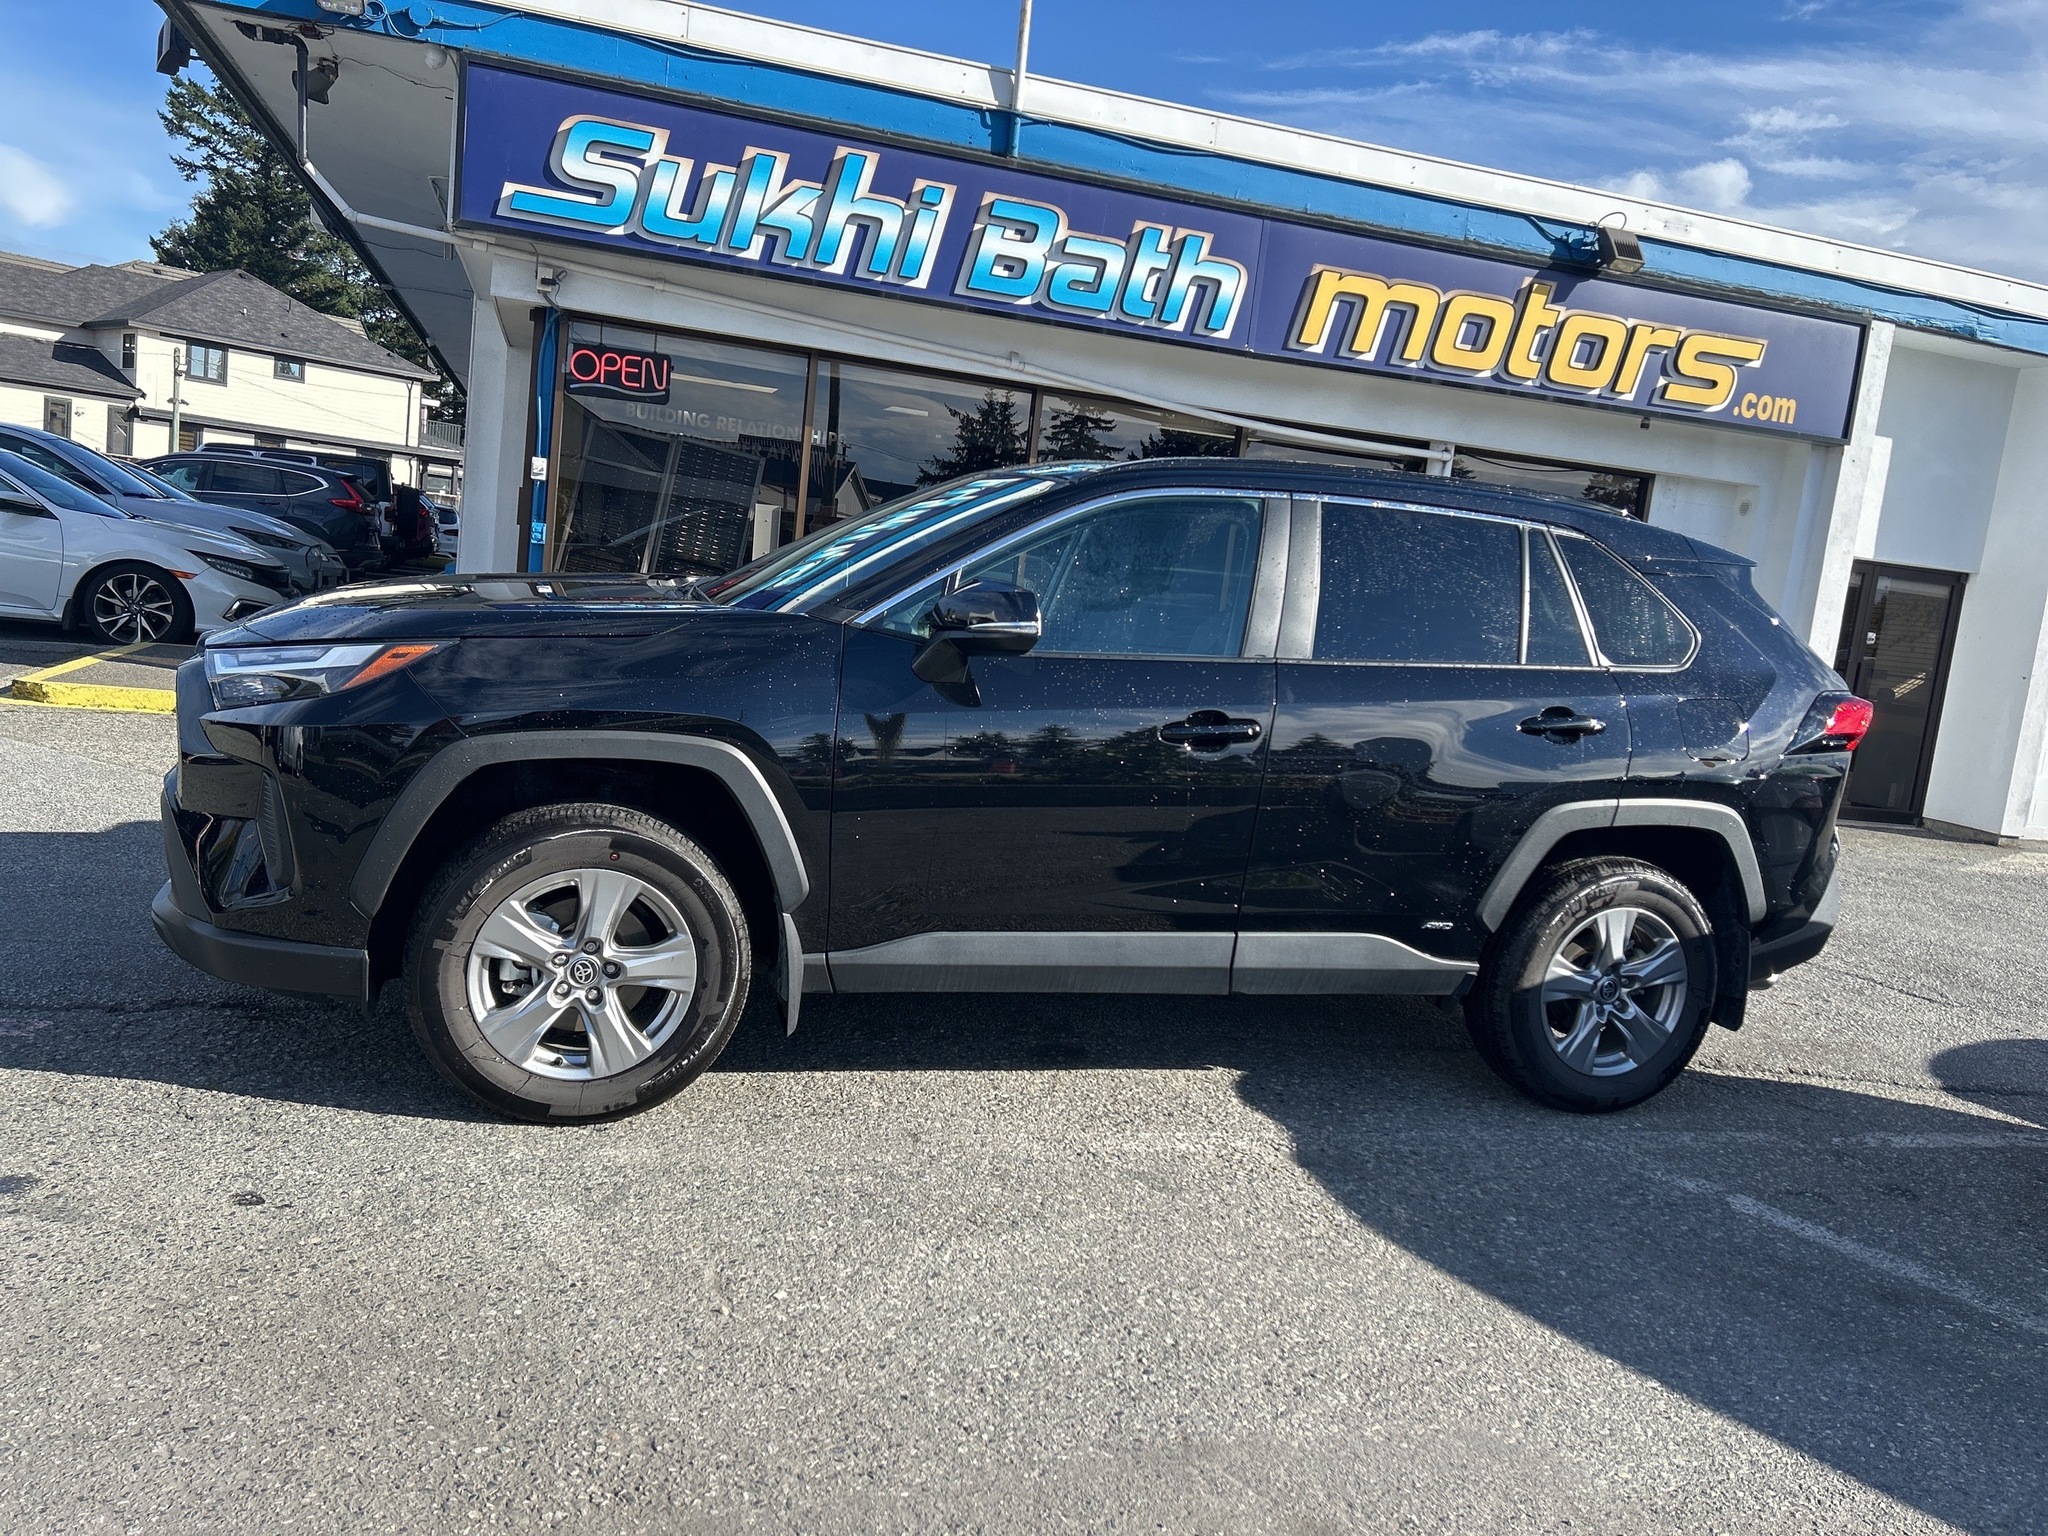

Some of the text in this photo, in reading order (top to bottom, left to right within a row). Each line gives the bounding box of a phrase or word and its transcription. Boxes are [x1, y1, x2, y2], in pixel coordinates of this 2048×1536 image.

[497, 113, 1797, 425] Sukhi Bath motors .com
[569, 349, 668, 391] OPEN
[625, 401, 848, 446] BUILDING RELATIONHIPS
